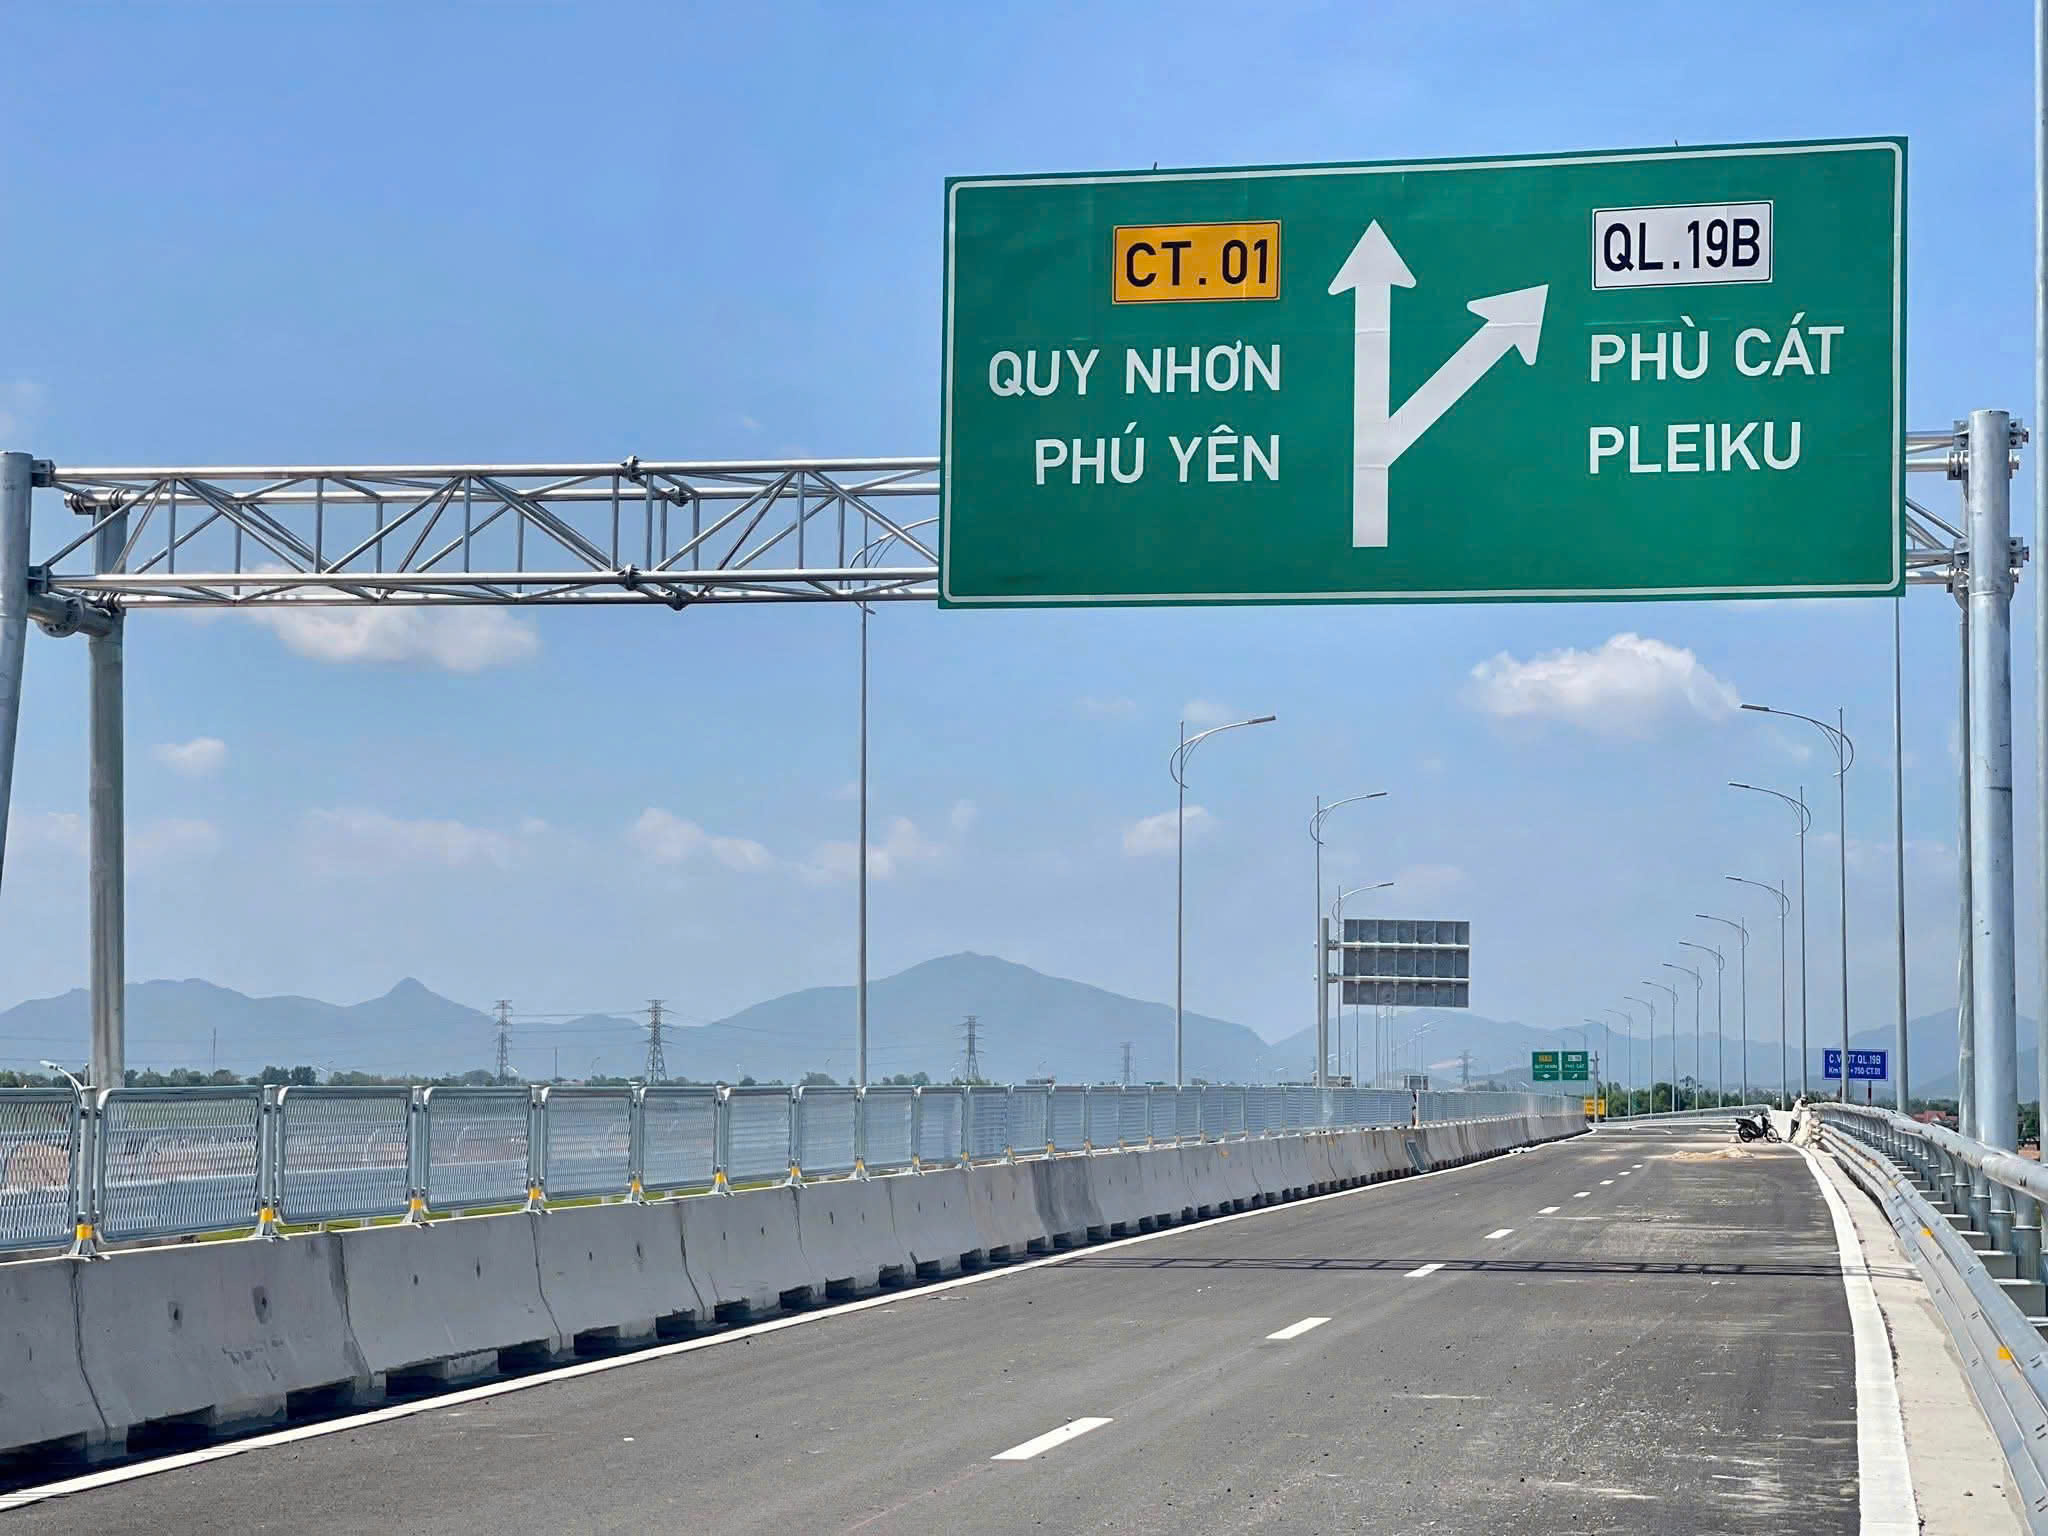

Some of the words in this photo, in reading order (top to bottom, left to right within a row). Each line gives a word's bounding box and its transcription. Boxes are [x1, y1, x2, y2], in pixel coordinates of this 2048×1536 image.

[1603, 218, 1760, 272] QL.19B
[989, 350, 1100, 397] QUY
[1125, 340, 1280, 394] NHƠN
[1590, 315, 1709, 382] PHÙ
[1735, 312, 1845, 377] CÁT
[1035, 421, 1145, 485] PHÚ
[1168, 424, 1280, 483] YÊN
[1589, 421, 1801, 474] PLEIKU
